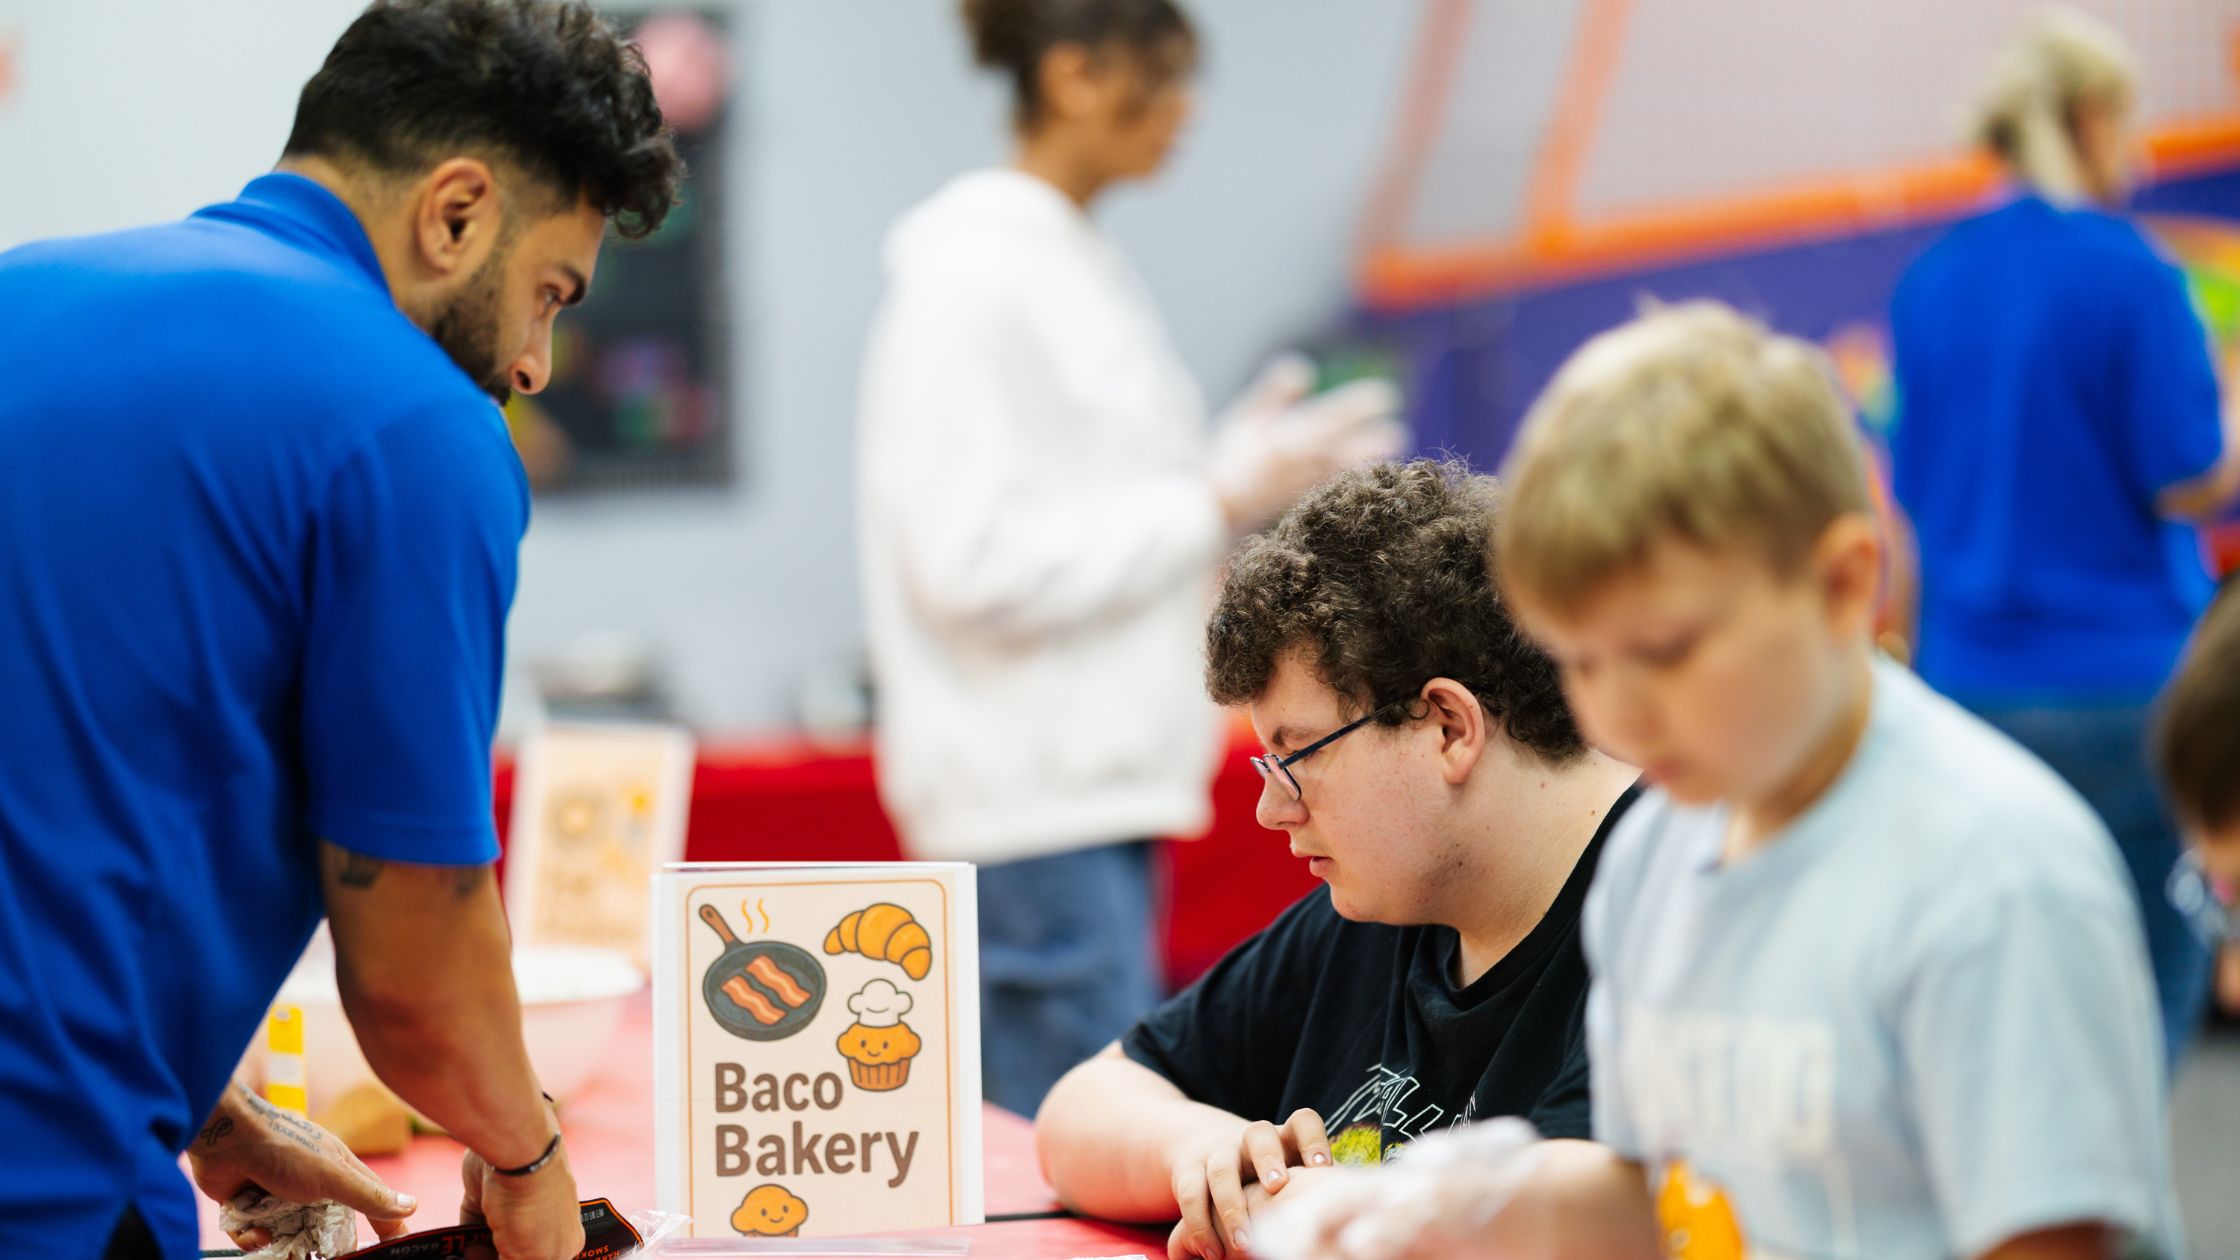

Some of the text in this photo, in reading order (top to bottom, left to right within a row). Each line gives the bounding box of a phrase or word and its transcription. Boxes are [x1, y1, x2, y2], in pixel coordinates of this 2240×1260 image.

[715, 1062, 843, 1113] Baco
[716, 1121, 919, 1188] Bakery
[391, 1242, 440, 1255] BACON
